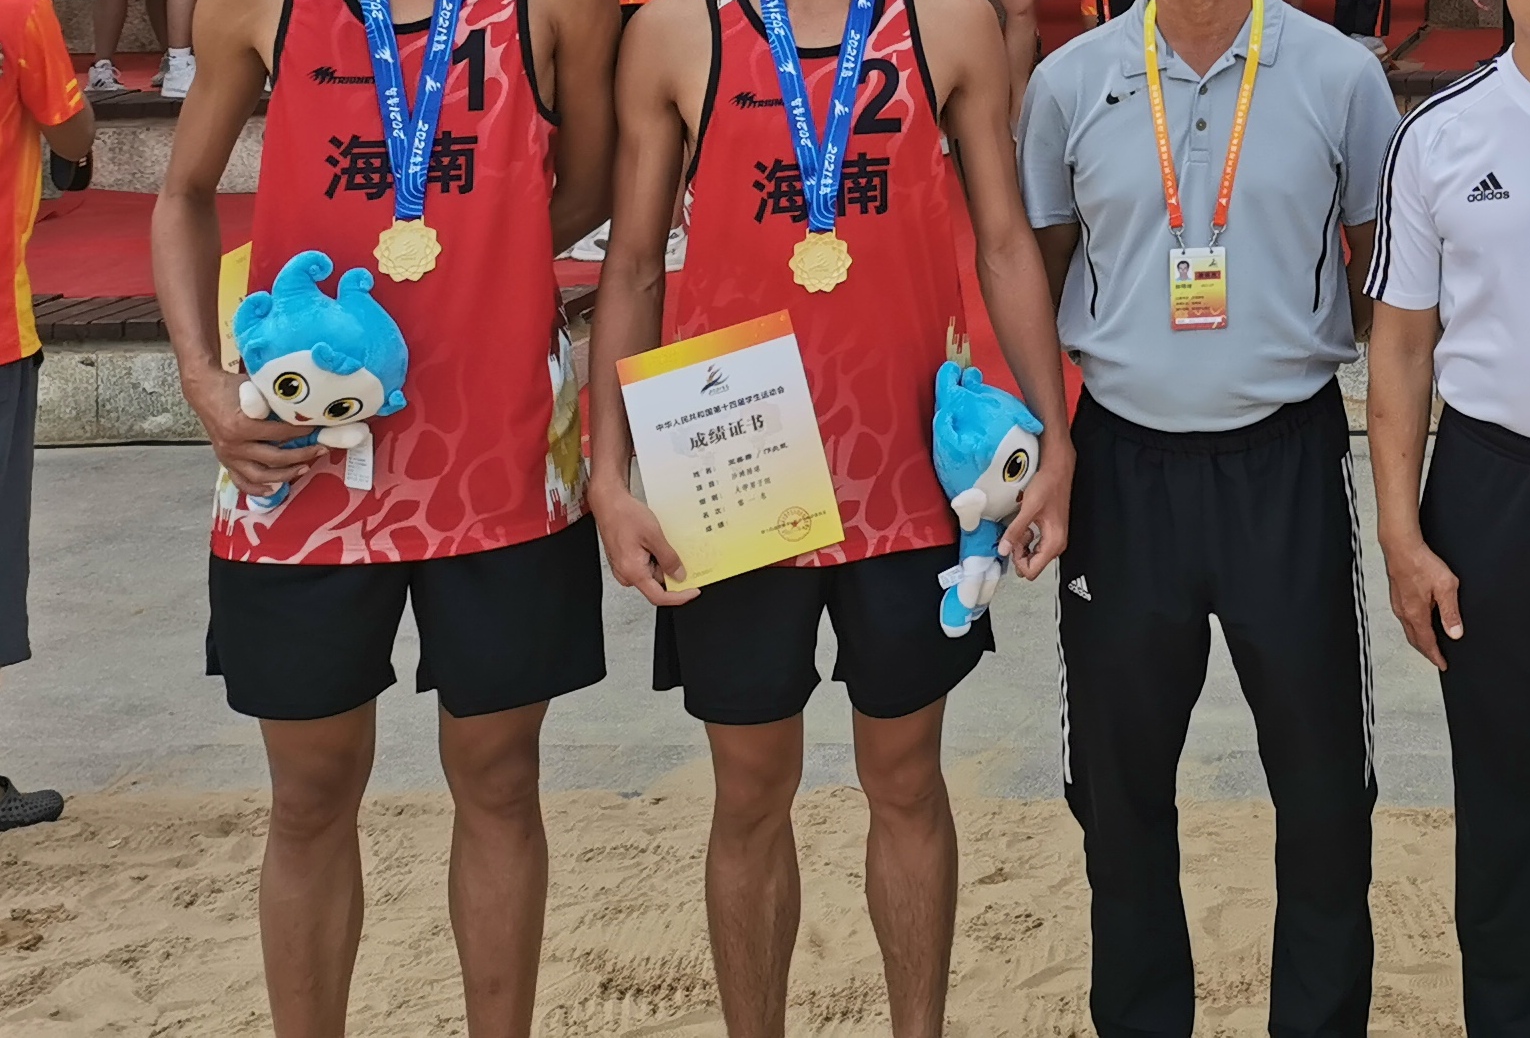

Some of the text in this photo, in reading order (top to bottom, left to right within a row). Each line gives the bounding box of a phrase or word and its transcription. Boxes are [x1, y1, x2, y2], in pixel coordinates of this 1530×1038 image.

[452, 28, 486, 112] 1
[854, 58, 902, 136] 2
[324, 130, 478, 201] 海南
[752, 152, 890, 224] 海南
[1467, 190, 1510, 203] adidas
[655, 385, 786, 432] 中华人民共和国第十四届学生运动会
[689, 414, 765, 451] 成绩证书
